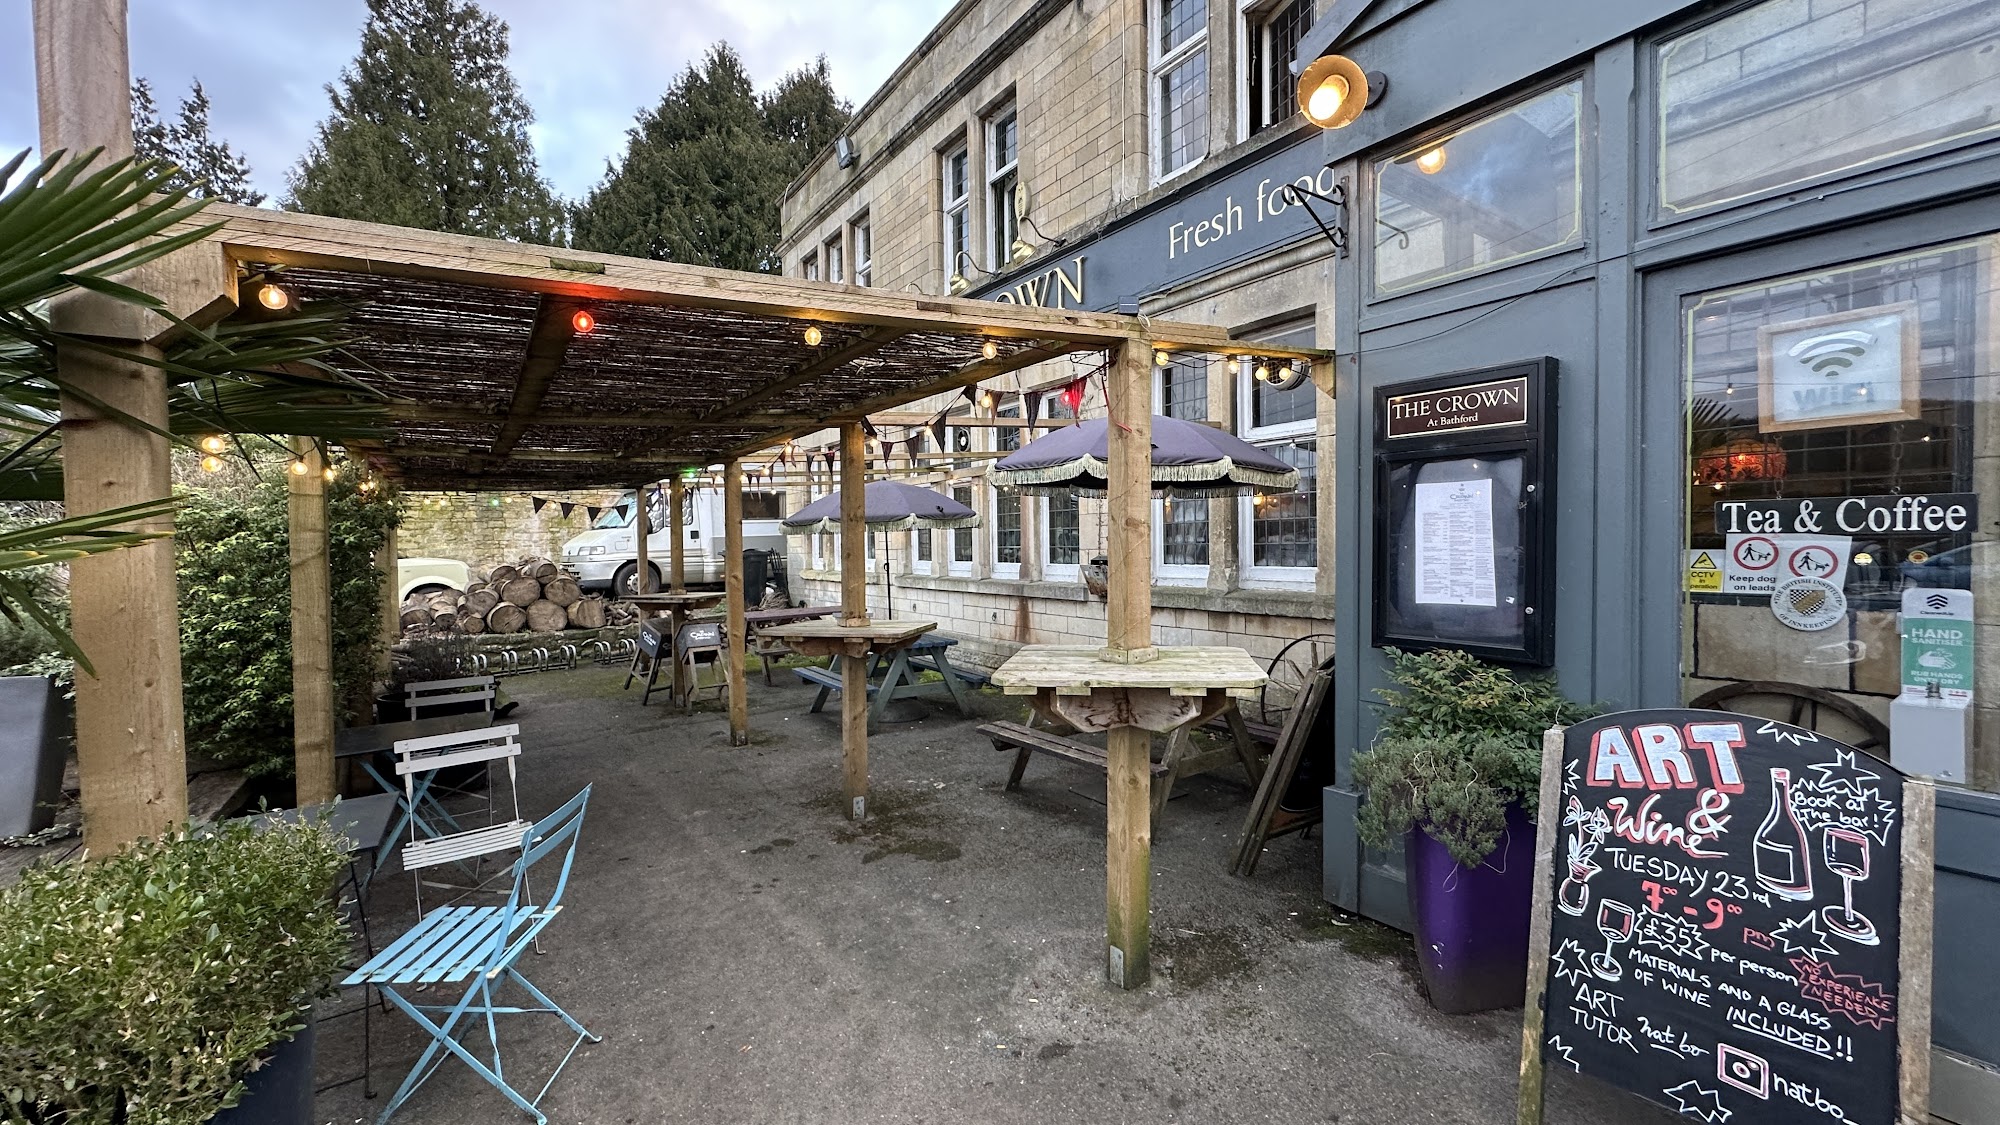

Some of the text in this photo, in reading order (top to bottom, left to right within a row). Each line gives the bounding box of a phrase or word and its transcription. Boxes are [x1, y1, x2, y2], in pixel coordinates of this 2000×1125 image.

[1168, 196, 1243, 260] Fresh
[1392, 386, 1519, 419] THE CROWN
[1427, 412, 1478, 427] At Bathford
[1722, 496, 1967, 533] Tea & Coffee
[1729, 575, 1754, 583] Keep
[1813, 579, 1843, 603] INSTITUTE
[1788, 616, 1837, 628] INNKEEPING
[1911, 628, 1963, 639] HAND
[1911, 638, 1963, 646] SANITISER
[1587, 722, 1746, 794] ART
[1607, 794, 1729, 858] Wine
[1685, 787, 1732, 841] &
[1604, 848, 1708, 897] TUESDAY
[1643, 917, 1798, 987] £35 per person
[1743, 927, 1776, 949] pm
[1802, 964, 1821, 975] NO
[1575, 983, 1624, 1018] ART
[1628, 948, 1832, 1030] MATERIALS AND A GLASS
[1634, 968, 1654, 986] OF
[1661, 978, 1711, 1008] WINE
[1811, 986, 1878, 1018] NEEDED
[1569, 1005, 1639, 1054] TUTOR
